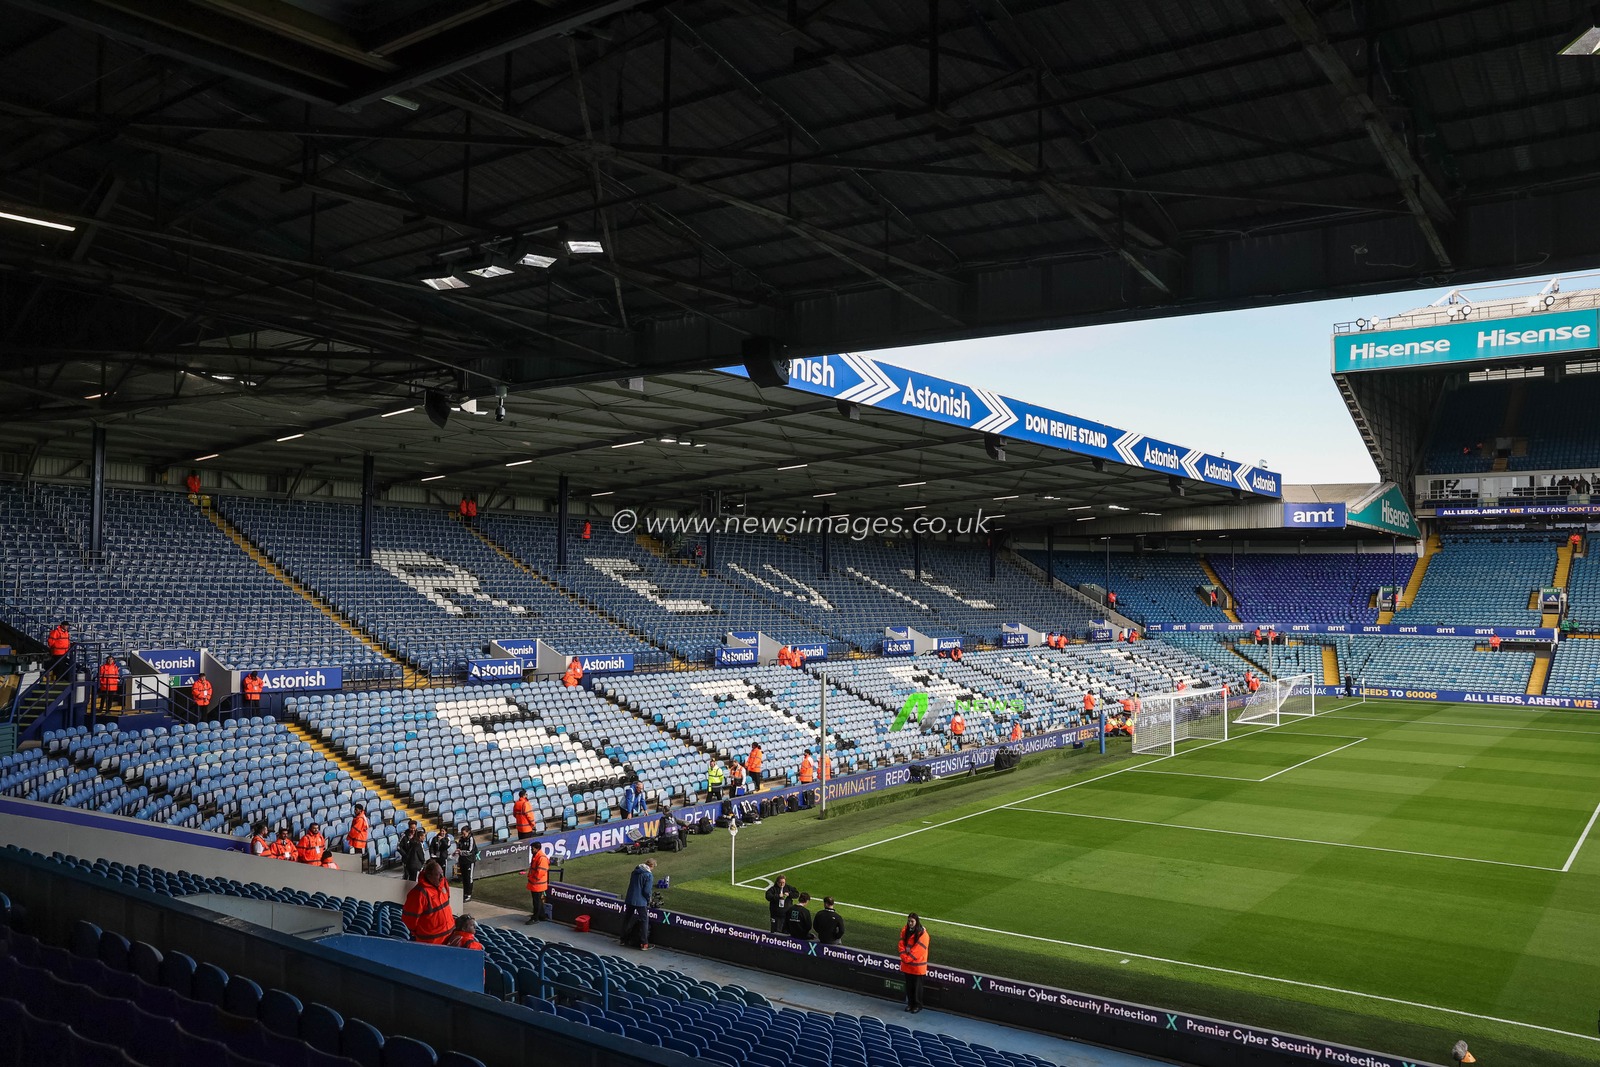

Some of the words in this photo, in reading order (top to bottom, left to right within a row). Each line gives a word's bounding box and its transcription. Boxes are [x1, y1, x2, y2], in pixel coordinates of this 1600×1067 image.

[1477, 324, 1591, 349] Hisense
[1350, 338, 1451, 361] Hisense
[902, 377, 971, 420] Astonish
[1025, 413, 1048, 435] DON
[1050, 420, 1078, 442] REVIE
[1078, 428, 1108, 449] STAND
[1144, 442, 1179, 470] Astonish
[1204, 458, 1233, 483] Astonish
[1252, 471, 1277, 493] Astonish
[1292, 507, 1335, 523] amt
[1381, 499, 1410, 530] Hisense
[1149, 623, 1162, 631] amt
[1173, 623, 1187, 631] amt
[1199, 623, 1214, 631] amt
[1228, 623, 1244, 631] amt
[1259, 623, 1275, 631] amt
[1292, 623, 1310, 631] amt
[1328, 624, 1345, 632] amt
[1436, 626, 1455, 634] amt
[1475, 627, 1494, 635] amt
[1515, 628, 1536, 636] amt
[940, 638, 961, 649] Astonish
[722, 649, 754, 662] Astonish
[471, 662, 521, 677] Astonish
[583, 656, 625, 671] Astonish
[262, 671, 326, 689] Astonish
[1335, 687, 1357, 695] TET
[1359, 688, 1388, 697] LEEDS
[1391, 690, 1404, 698] TO
[1405, 691, 1438, 700] 60006
[1464, 693, 1484, 702] ALL
[1486, 694, 1525, 705] LEEDS,
[1527, 696, 1571, 707] AREN'T
[1573, 699, 1599, 708] WE?
[885, 769, 910, 787] REPO
[971, 751, 987, 765] AND
[1062, 731, 1076, 744] TEXT
[485, 846, 509, 858] Premier
[510, 844, 529, 856] Cyber
[551, 887, 575, 901] Premier
[575, 893, 595, 907] Cyber
[596, 899, 623, 914] Security
[675, 915, 703, 930] Premier
[704, 922, 727, 936] Cyber
[728, 927, 760, 945] Security
[761, 933, 802, 951] Protection
[823, 946, 856, 962] Premier
[856, 953, 882, 968] Cyber
[926, 969, 966, 985] rotection
[989, 979, 1027, 998] Premier
[1028, 988, 1058, 1003] Cyber
[1059, 994, 1102, 1015] Security
[1103, 1002, 1158, 1024] Protection
[1186, 1019, 1231, 1038] Premier
[1232, 1028, 1269, 1046] Cyber
[1271, 1036, 1322, 1060] Security
[1325, 1047, 1391, 1067] Protection
